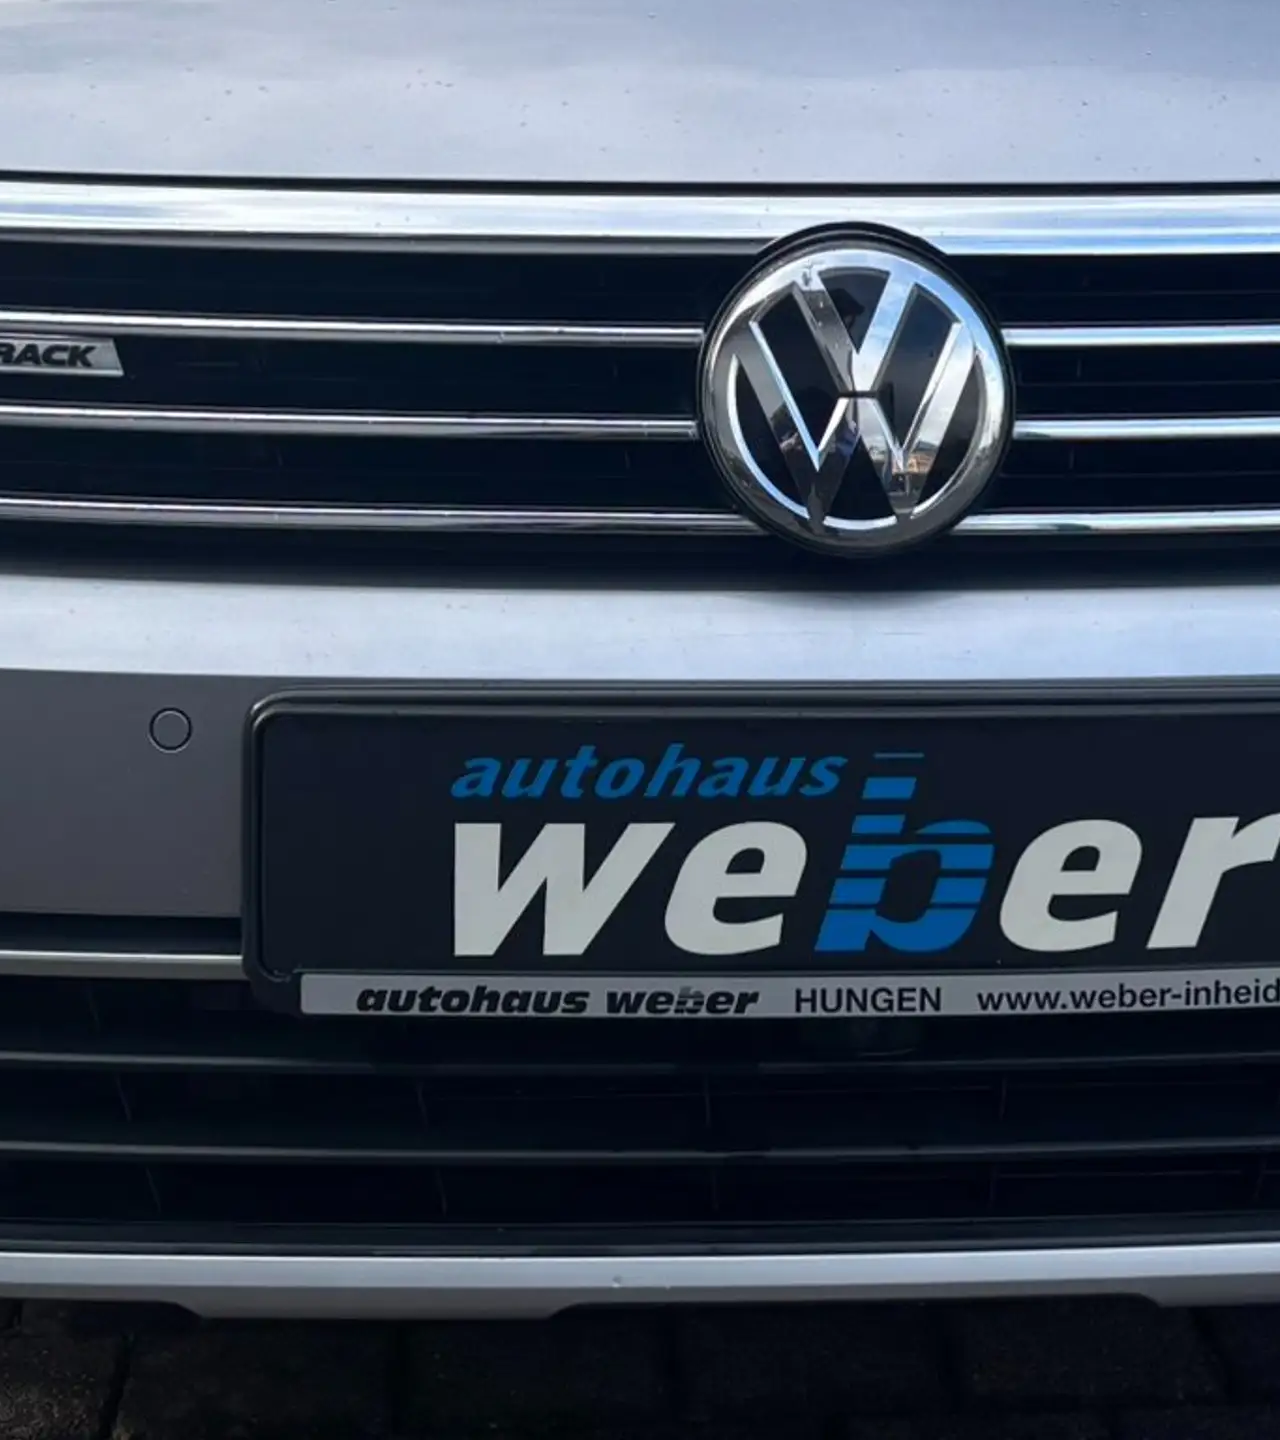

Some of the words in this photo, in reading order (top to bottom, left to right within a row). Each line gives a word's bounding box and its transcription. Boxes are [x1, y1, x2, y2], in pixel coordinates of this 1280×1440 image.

[449, 743, 847, 802] autohaus
[356, 984, 591, 1014] autohaus
[605, 984, 760, 1015] weber
[794, 986, 943, 1013] HUNGEN
